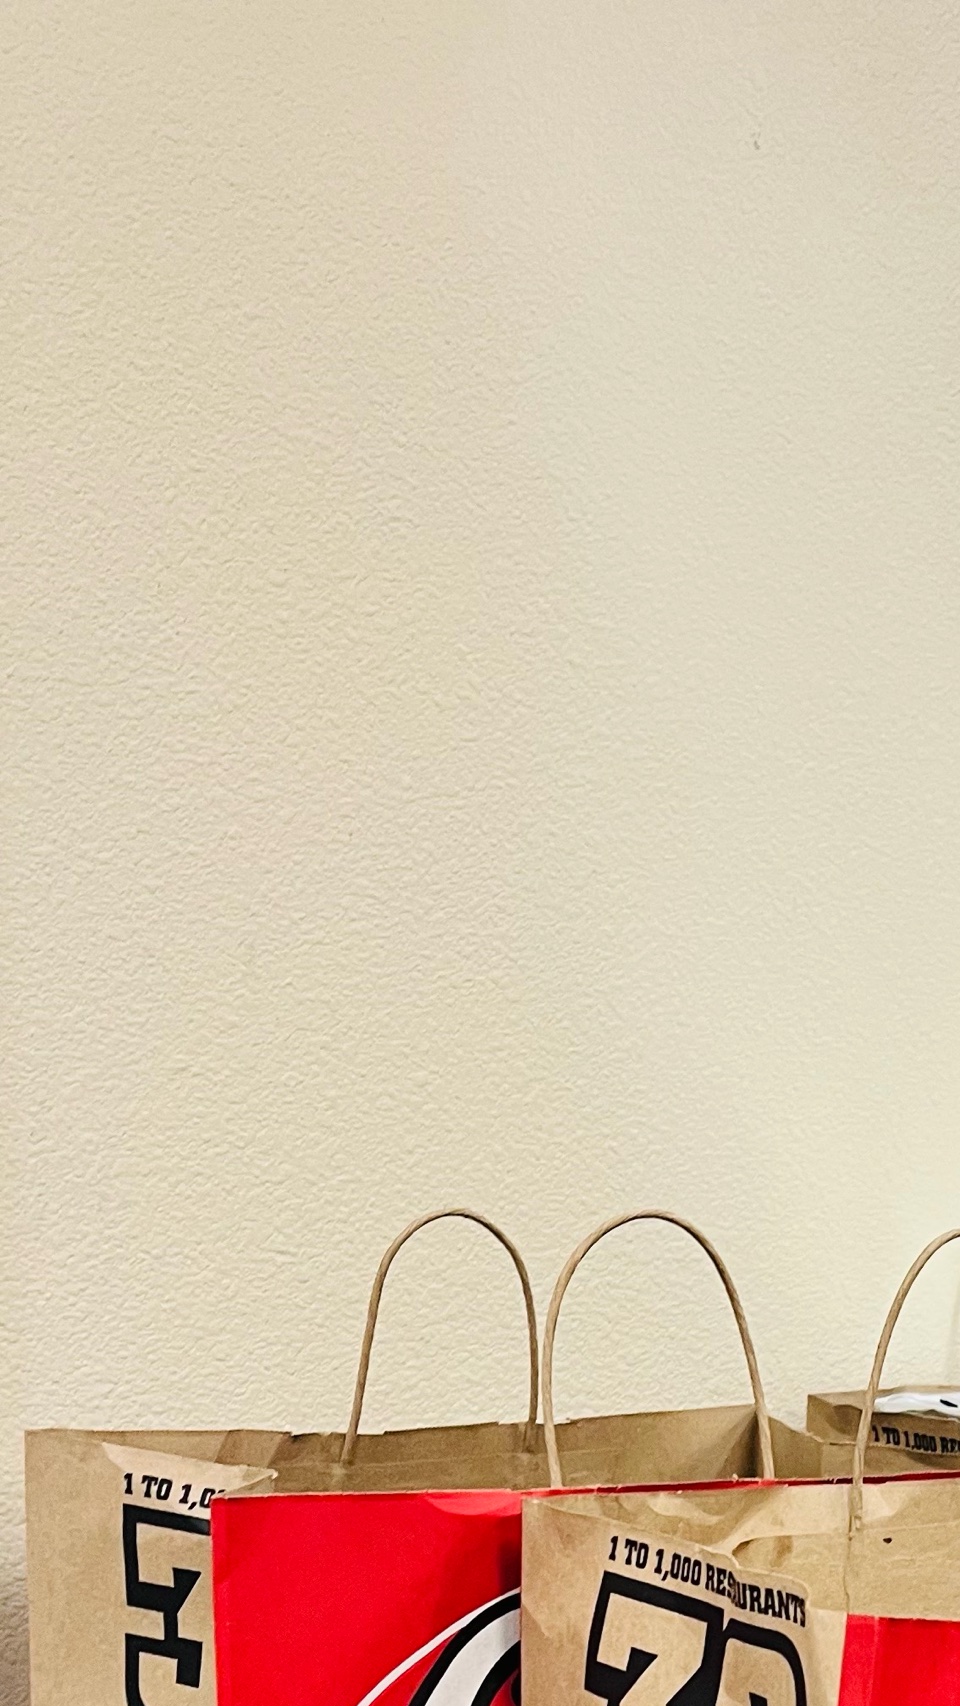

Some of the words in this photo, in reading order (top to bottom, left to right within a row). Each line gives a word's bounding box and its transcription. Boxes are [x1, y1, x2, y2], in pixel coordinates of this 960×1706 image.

[124, 1473, 133, 1495] 1
[141, 1475, 173, 1500] TO
[179, 1484, 225, 1510] 1,0
[609, 1536, 618, 1561] 1
[624, 1538, 649, 1569] TO
[654, 1548, 701, 1585] 1,000
